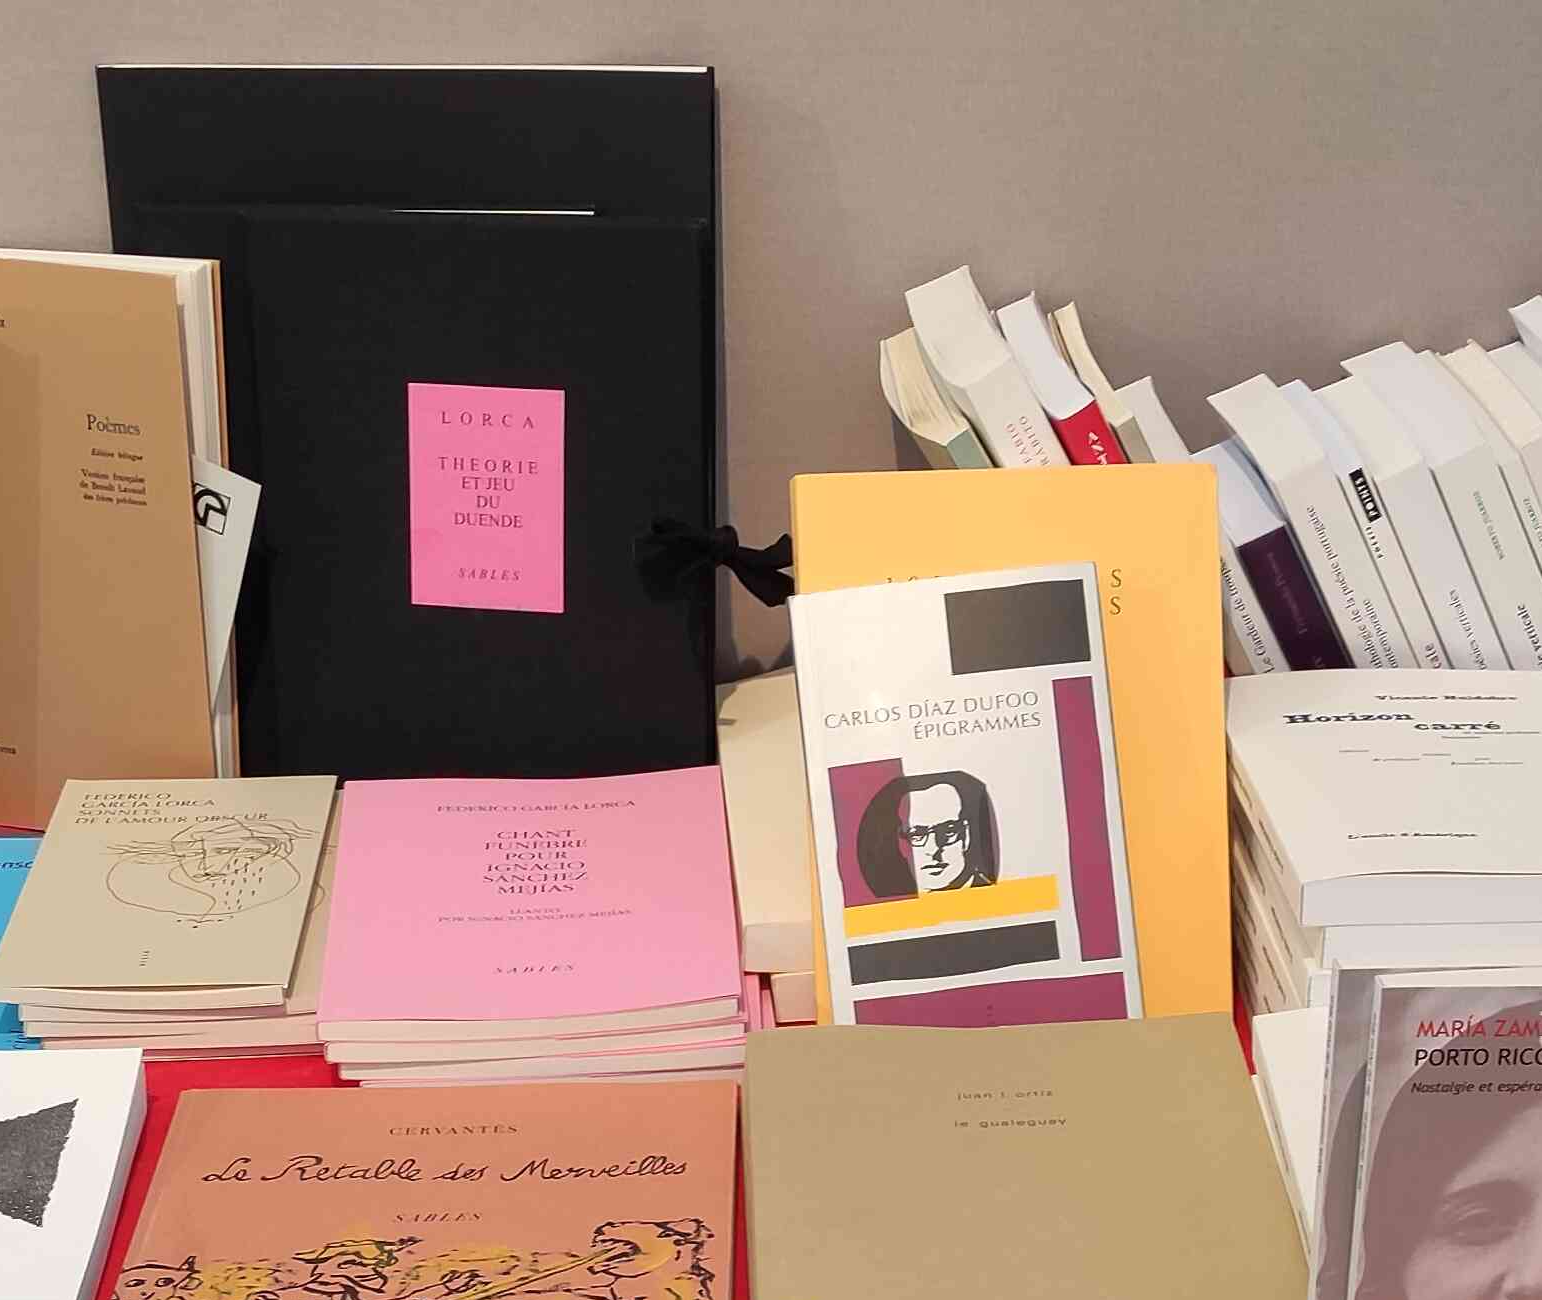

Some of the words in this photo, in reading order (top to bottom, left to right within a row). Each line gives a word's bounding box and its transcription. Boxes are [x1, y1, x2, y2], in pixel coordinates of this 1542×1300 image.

[87, 414, 140, 436] Poèmes
[463, 477, 480, 490] ET
[486, 478, 515, 491] JEU
[477, 495, 501, 509] DU
[454, 513, 523, 528] DUENDE
[459, 569, 520, 581] SABLES
[1518, 606, 1541, 652] verticale
[825, 706, 901, 730] CARLOS
[909, 698, 955, 719] DÍAZ
[963, 691, 1039, 713] DUFOO
[1283, 712, 1413, 723] Horizon
[914, 711, 1041, 740] ÉPIGRAMMES
[1414, 720, 1502, 731] carré
[497, 830, 576, 840] CHANT
[505, 851, 567, 860] POUR
[487, 860, 586, 872] IGNACIO
[1416, 1015, 1488, 1037] MARÍA
[1414, 1047, 1489, 1066] PORTO
[1411, 1080, 1474, 1094] Nostalgie
[1478, 1081, 1493, 1092] et
[392, 1212, 483, 1223] SABLES
